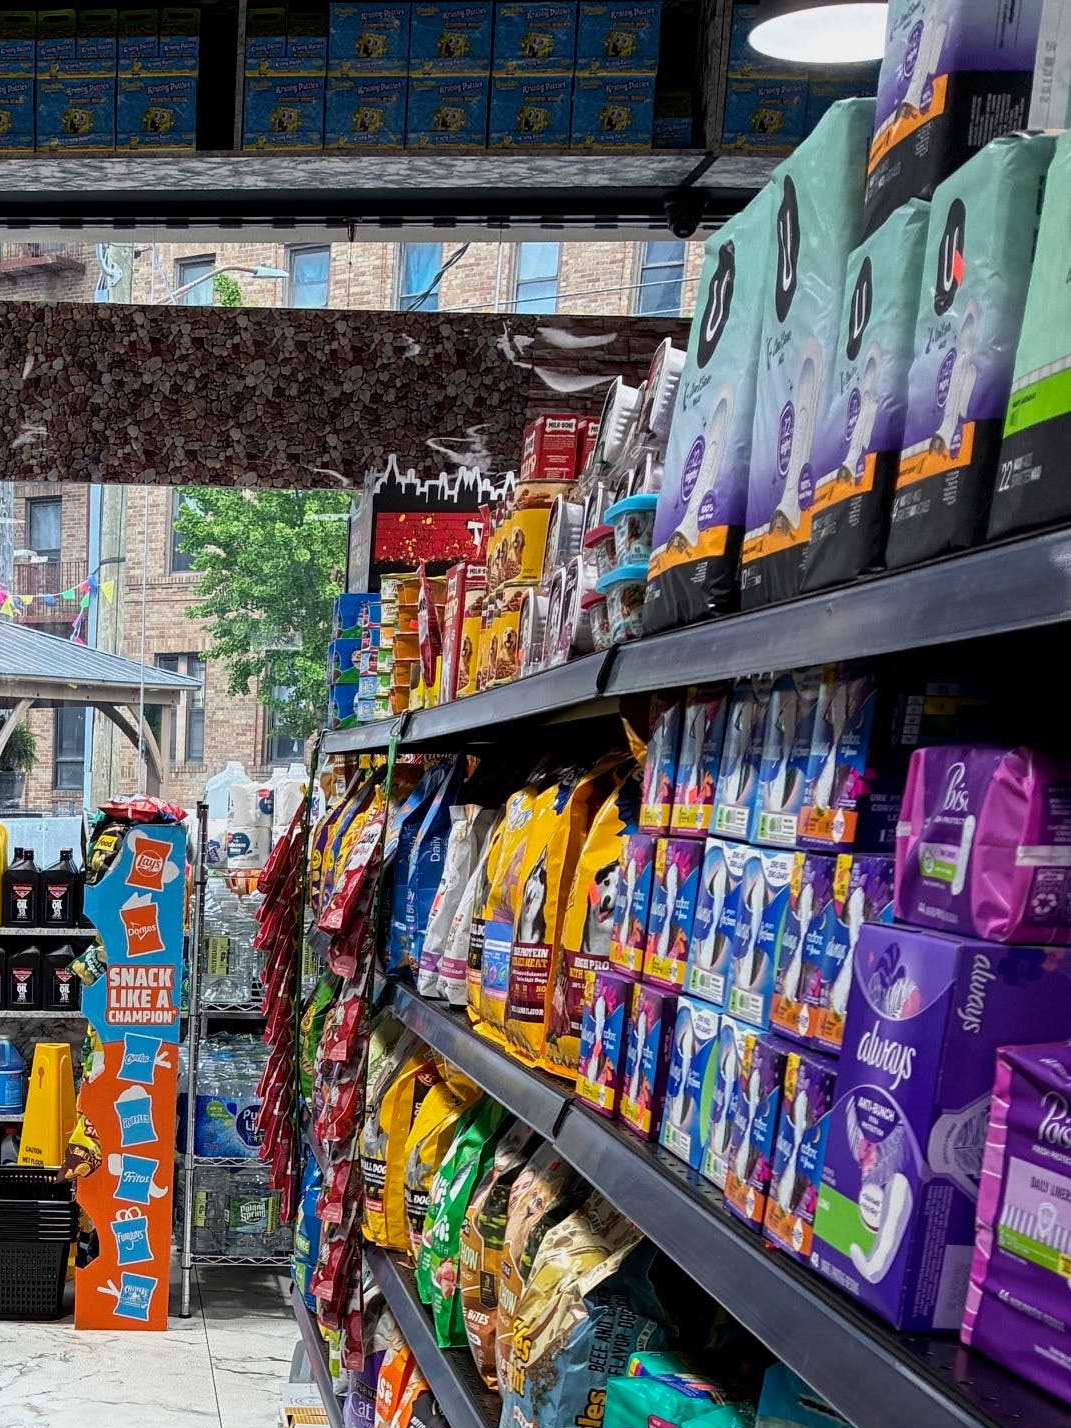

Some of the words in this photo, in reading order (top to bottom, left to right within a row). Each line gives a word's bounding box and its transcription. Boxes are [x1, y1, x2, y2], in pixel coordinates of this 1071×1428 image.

[109, 968, 172, 987] SNACK
[110, 989, 152, 1008] LIKE
[157, 989, 170, 1008] A
[962, 953, 997, 1034] always
[108, 1010, 173, 1023] CHAMPION
[856, 1020, 916, 1091] always
[123, 1171, 150, 1184] Fritos
[594, 1321, 614, 1344] AND
[588, 1345, 608, 1373] BEEF
[608, 1333, 631, 1376] FLAVOR
